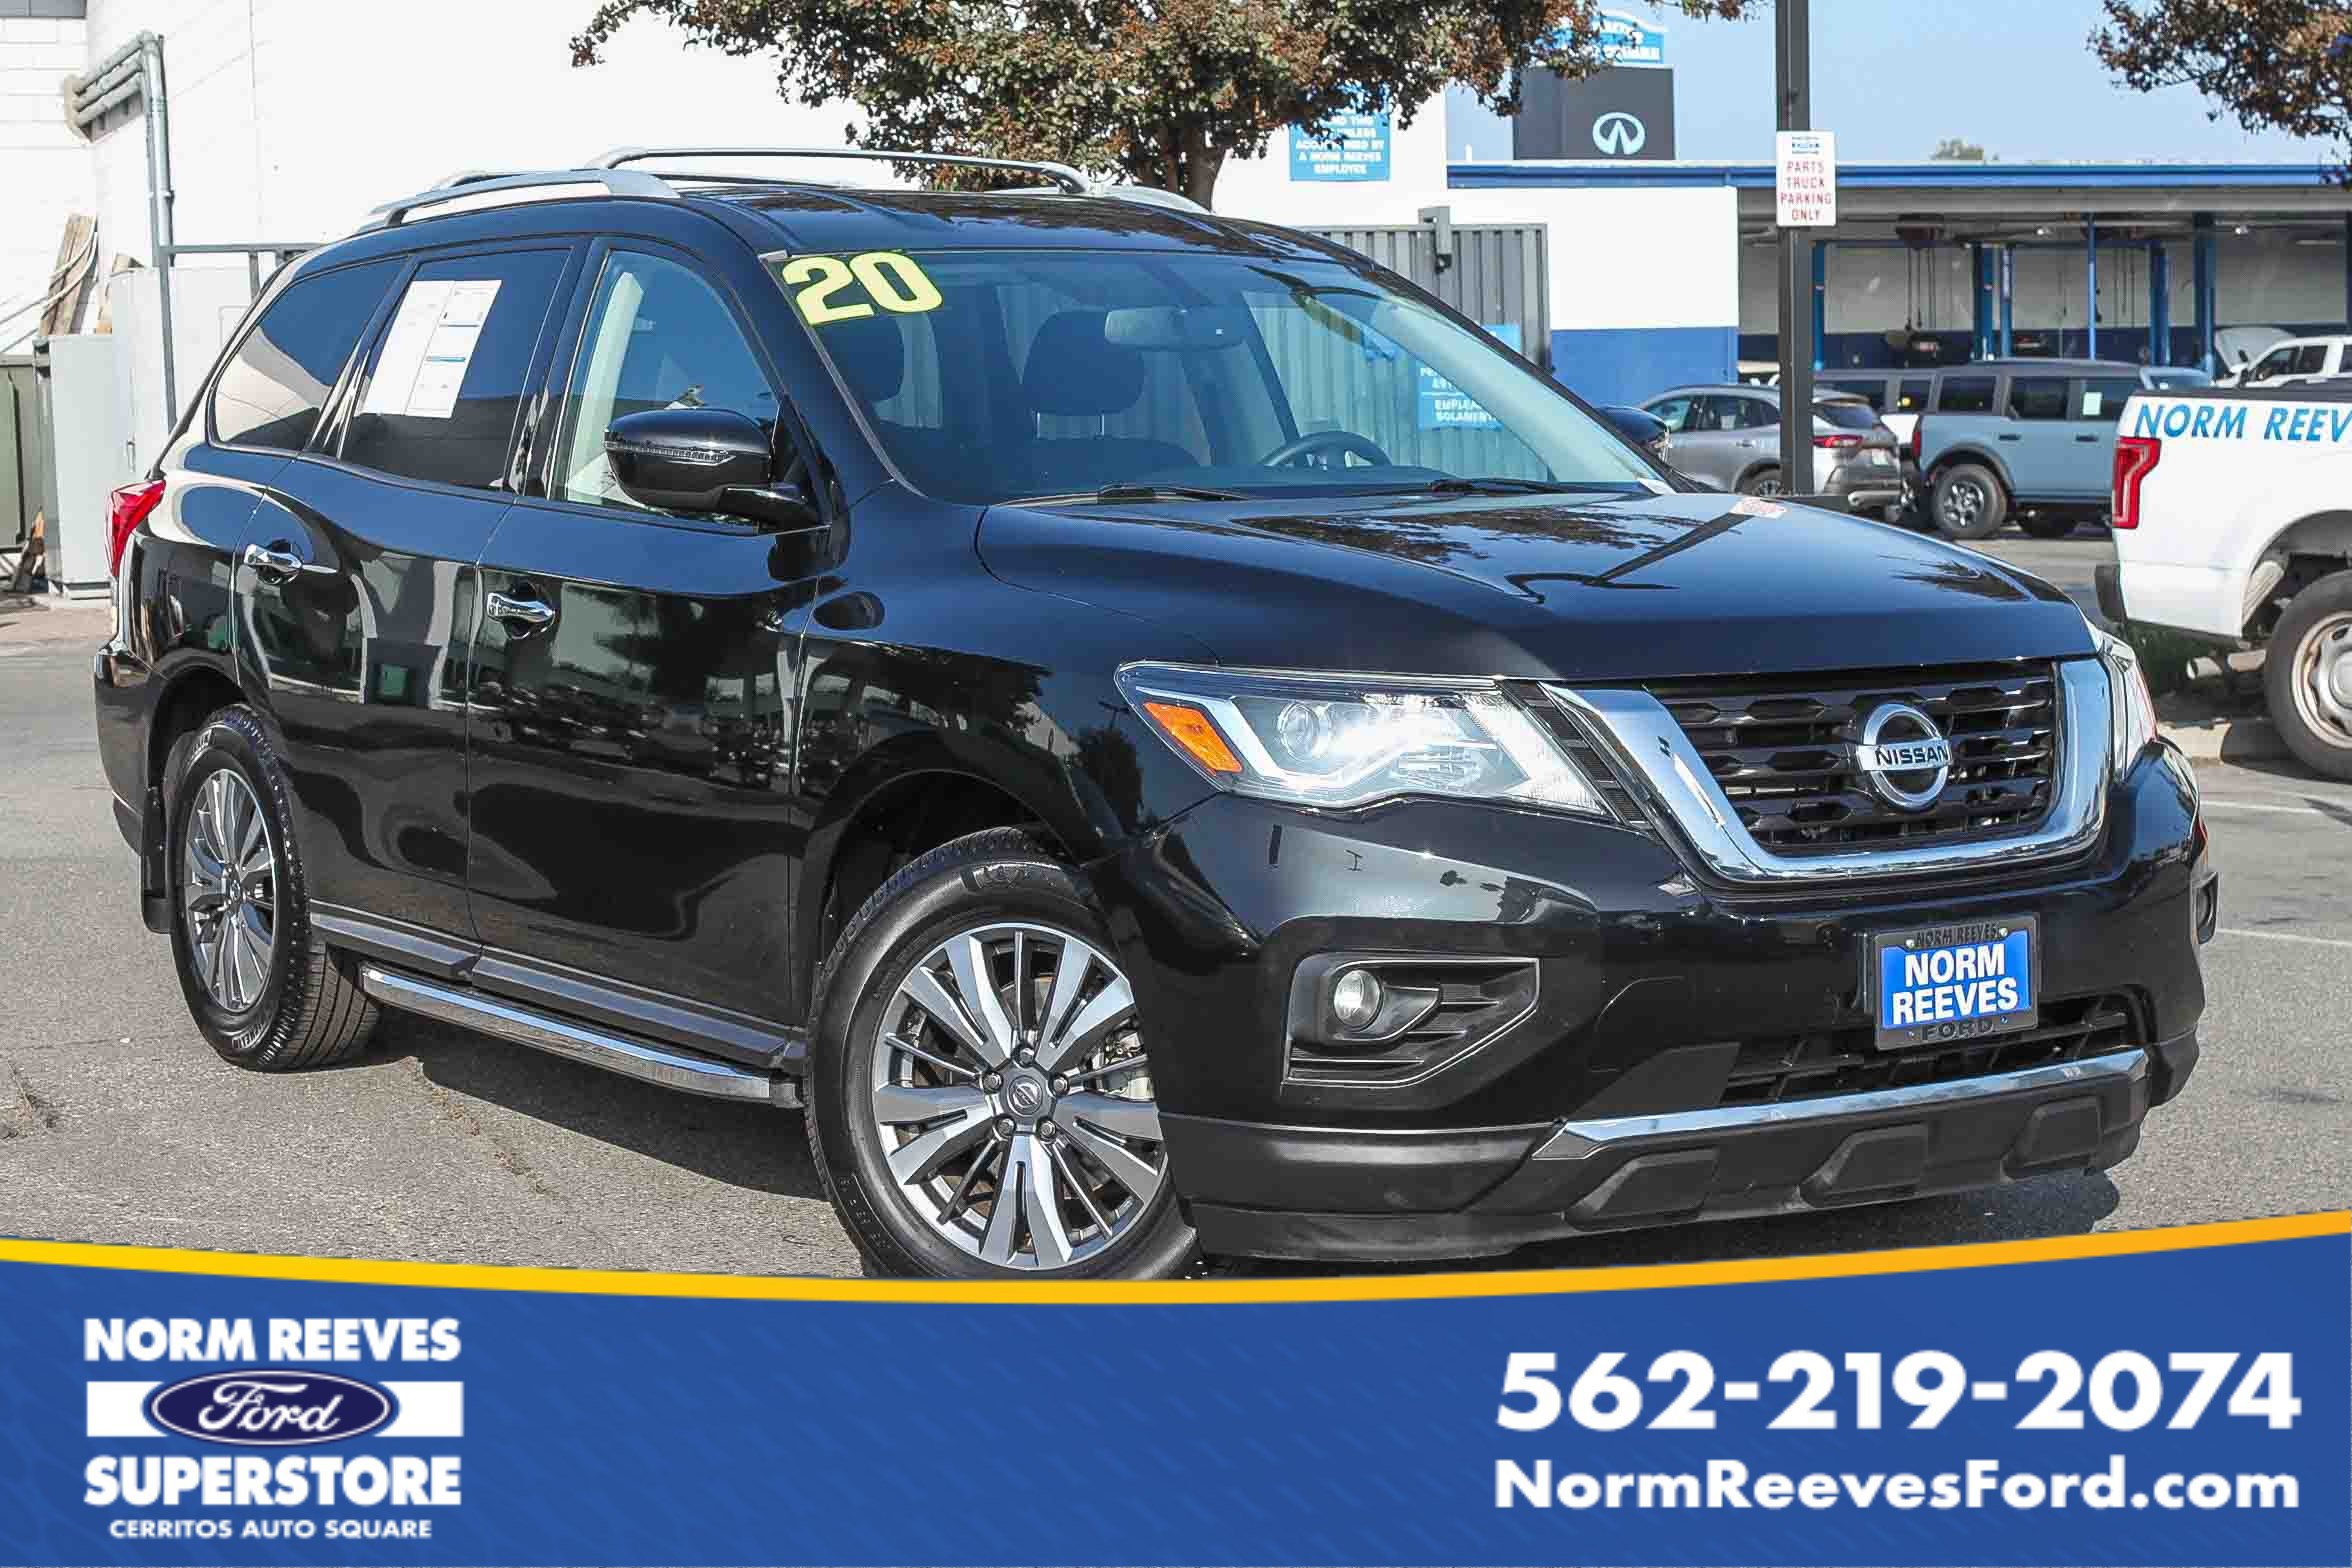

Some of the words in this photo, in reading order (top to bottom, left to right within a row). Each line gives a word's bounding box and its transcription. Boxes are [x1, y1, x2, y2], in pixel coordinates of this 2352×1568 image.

[1786, 160, 1825, 173] PARTS
[1786, 176, 1825, 189] TRUCK
[1779, 192, 1833, 205] PARKING
[1791, 207, 1820, 221] ONLY
[782, 251, 943, 325] 20
[2134, 404, 2247, 439] NORM
[2264, 407, 2352, 442] REEV
[1875, 744, 1949, 766] NISSAN
[1915, 925, 1955, 947] NORM
[1958, 922, 2001, 944] REEVES
[1904, 943, 2005, 987] NORM
[1892, 977, 2018, 1025] REEVES
